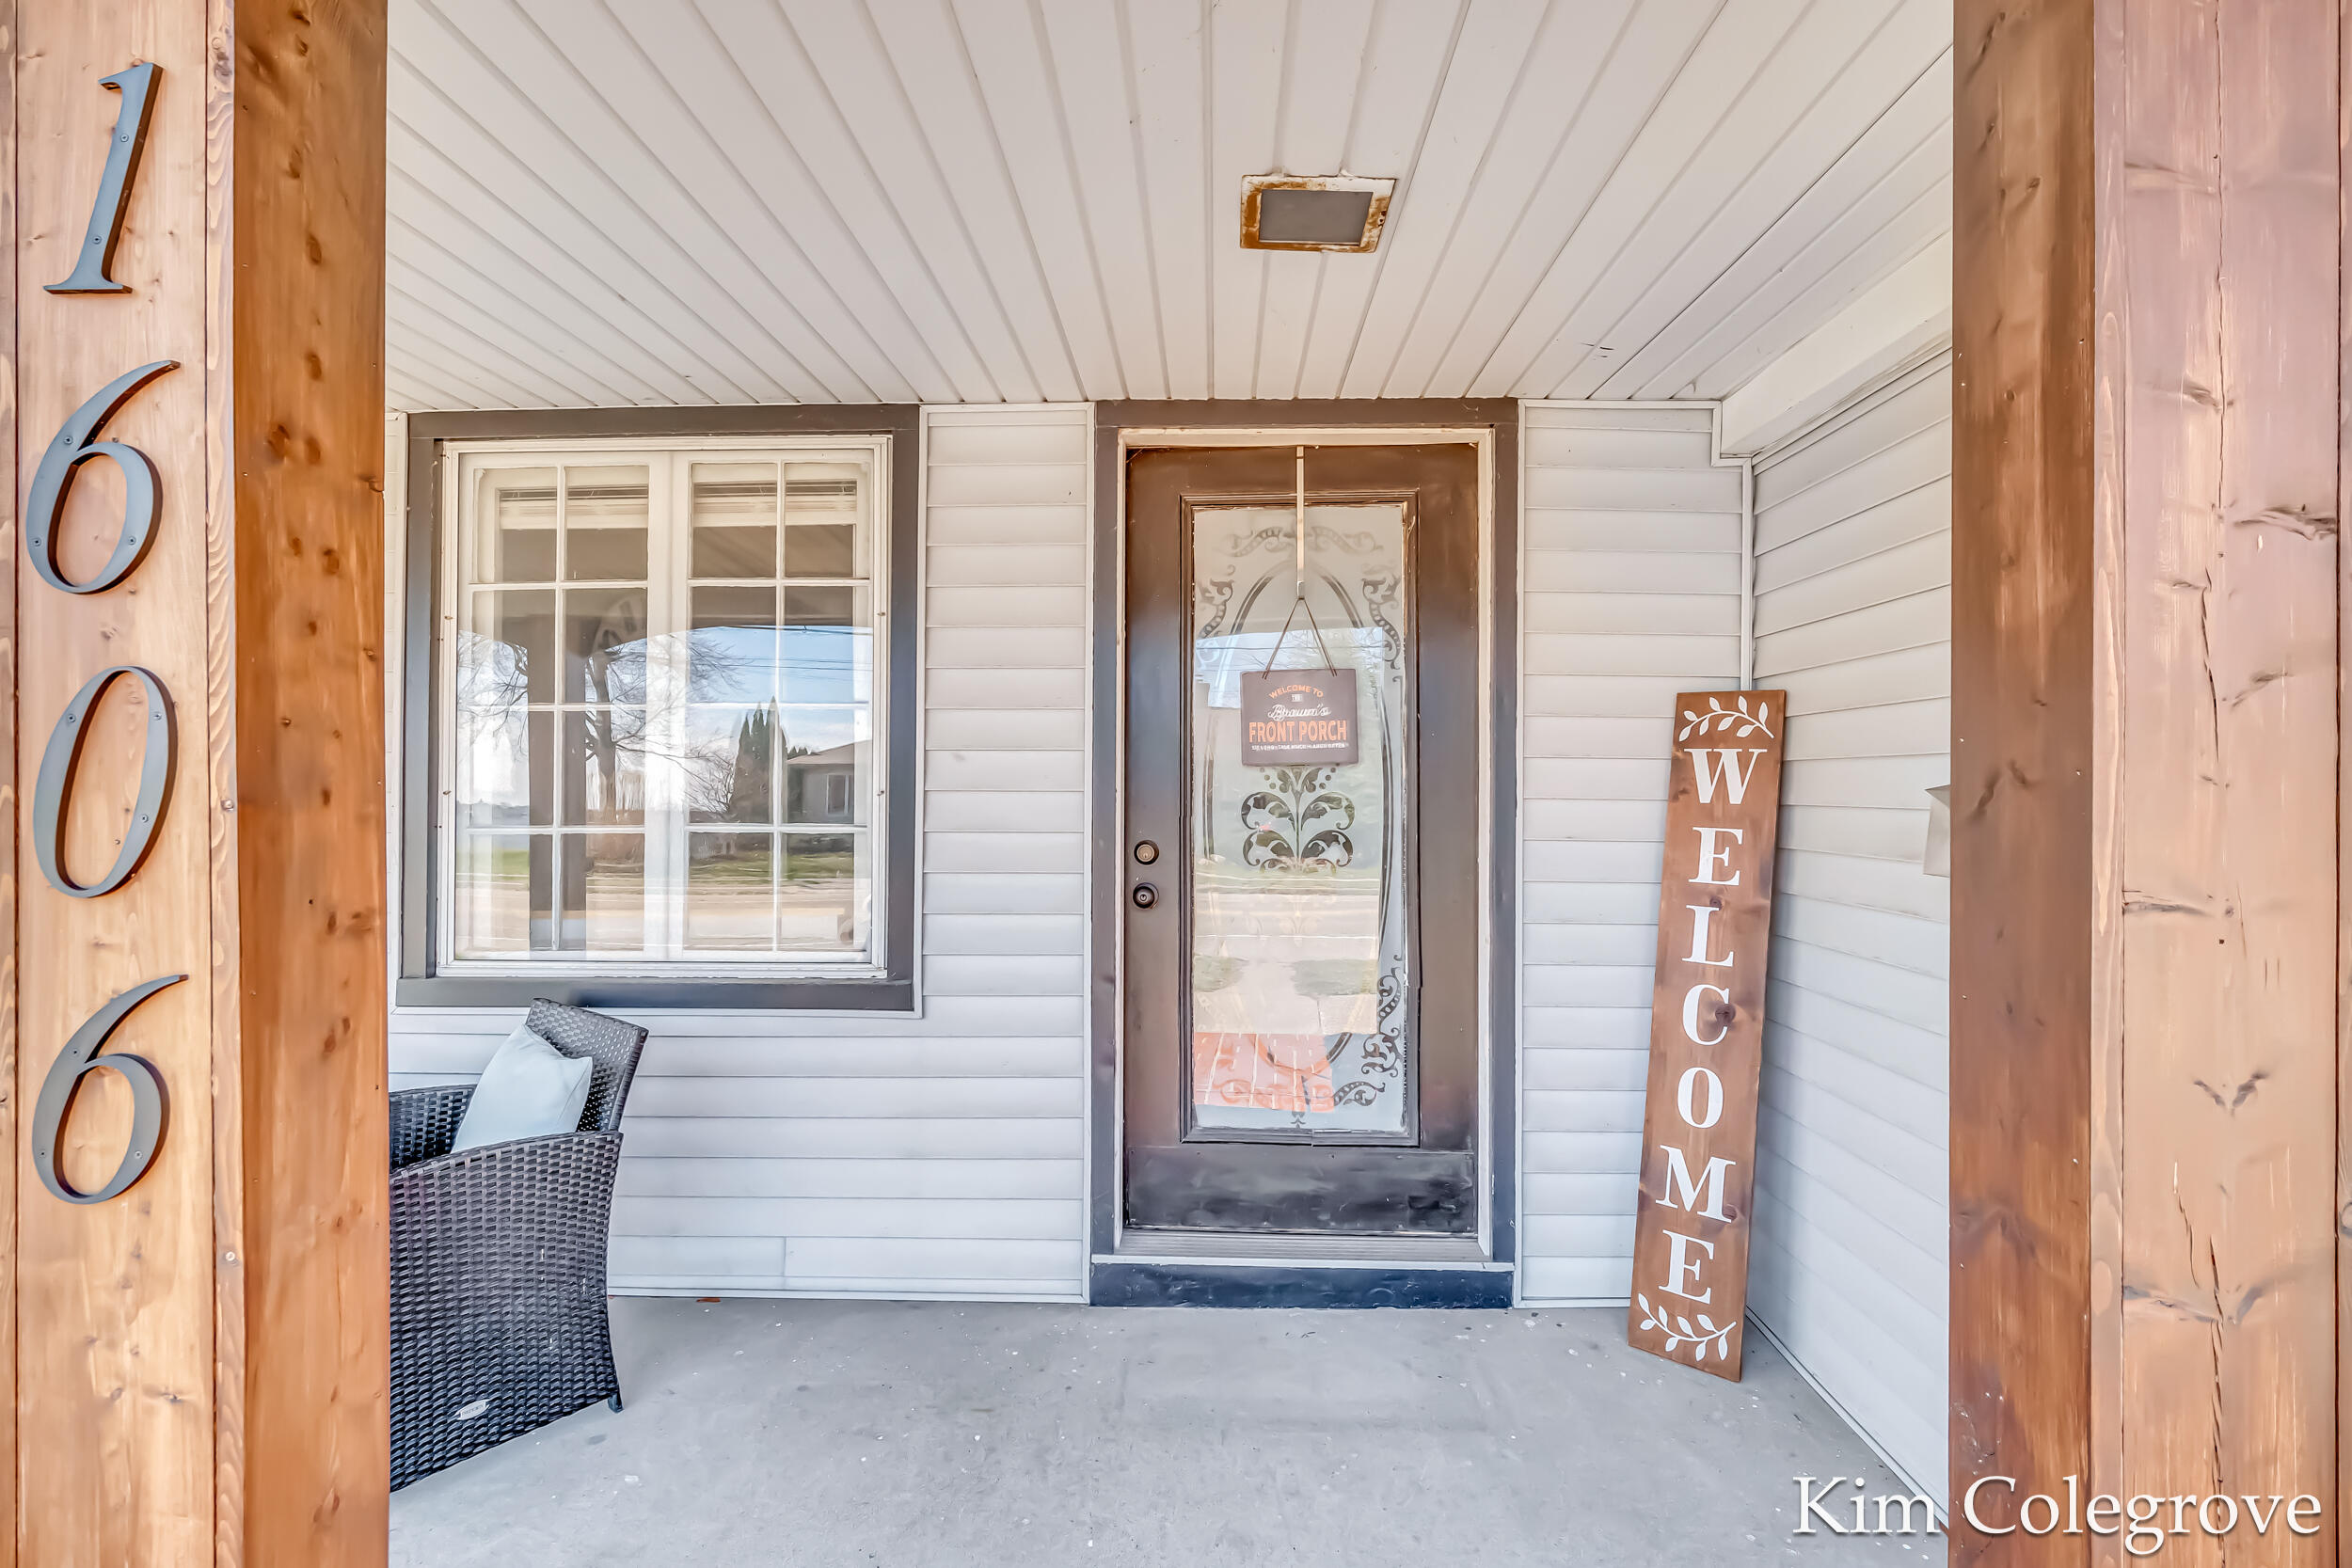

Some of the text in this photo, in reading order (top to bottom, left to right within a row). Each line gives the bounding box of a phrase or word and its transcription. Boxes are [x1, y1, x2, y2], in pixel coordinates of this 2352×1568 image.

[25, 62, 188, 1205] 1606
[1248, 720, 1347, 743] FRONT PORCH
[1269, 685, 1311, 698] WELCOME
[1312, 688, 1324, 698] TO
[1654, 747, 1768, 1306] WELCOME
